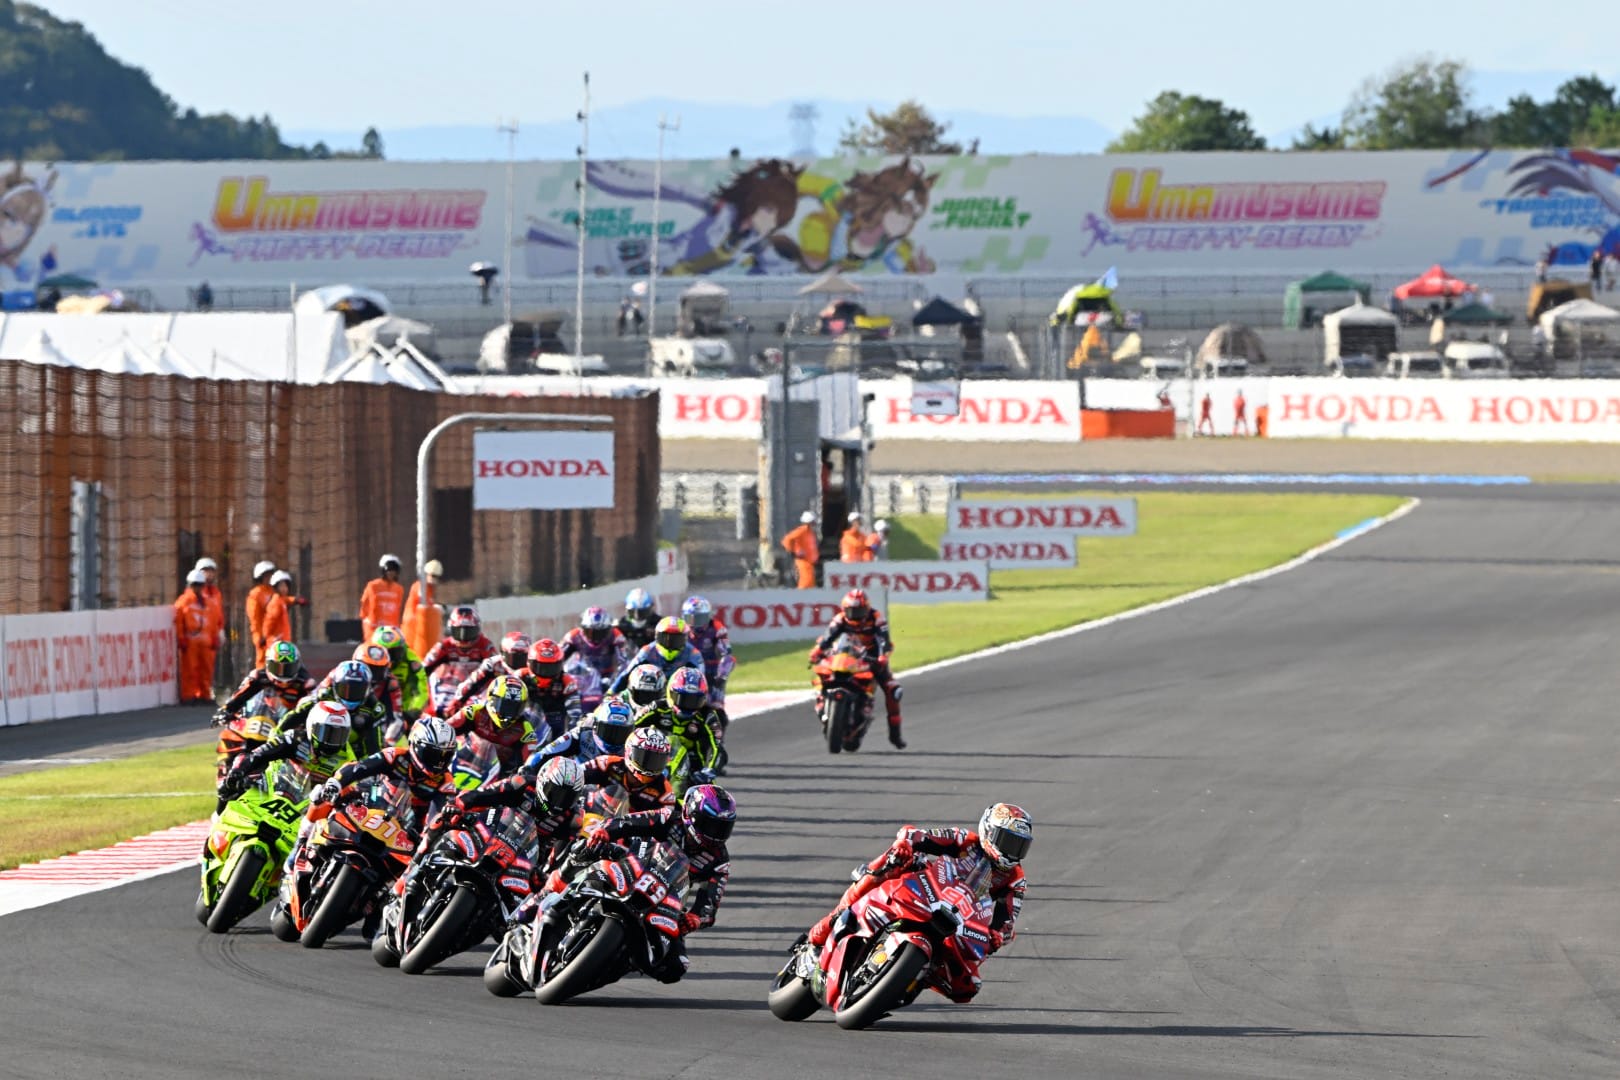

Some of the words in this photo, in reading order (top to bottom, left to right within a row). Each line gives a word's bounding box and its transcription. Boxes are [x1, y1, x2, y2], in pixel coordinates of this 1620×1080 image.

[1280, 395, 1446, 423] HONDA
[478, 460, 611, 478] HONDA
[958, 506, 1126, 529] HONDA
[942, 542, 1070, 561] HONDA
[259, 799, 301, 825] 49
[363, 814, 398, 839] 37
[919, 873, 936, 902] Lenovo
[964, 928, 988, 942] Lenovo
